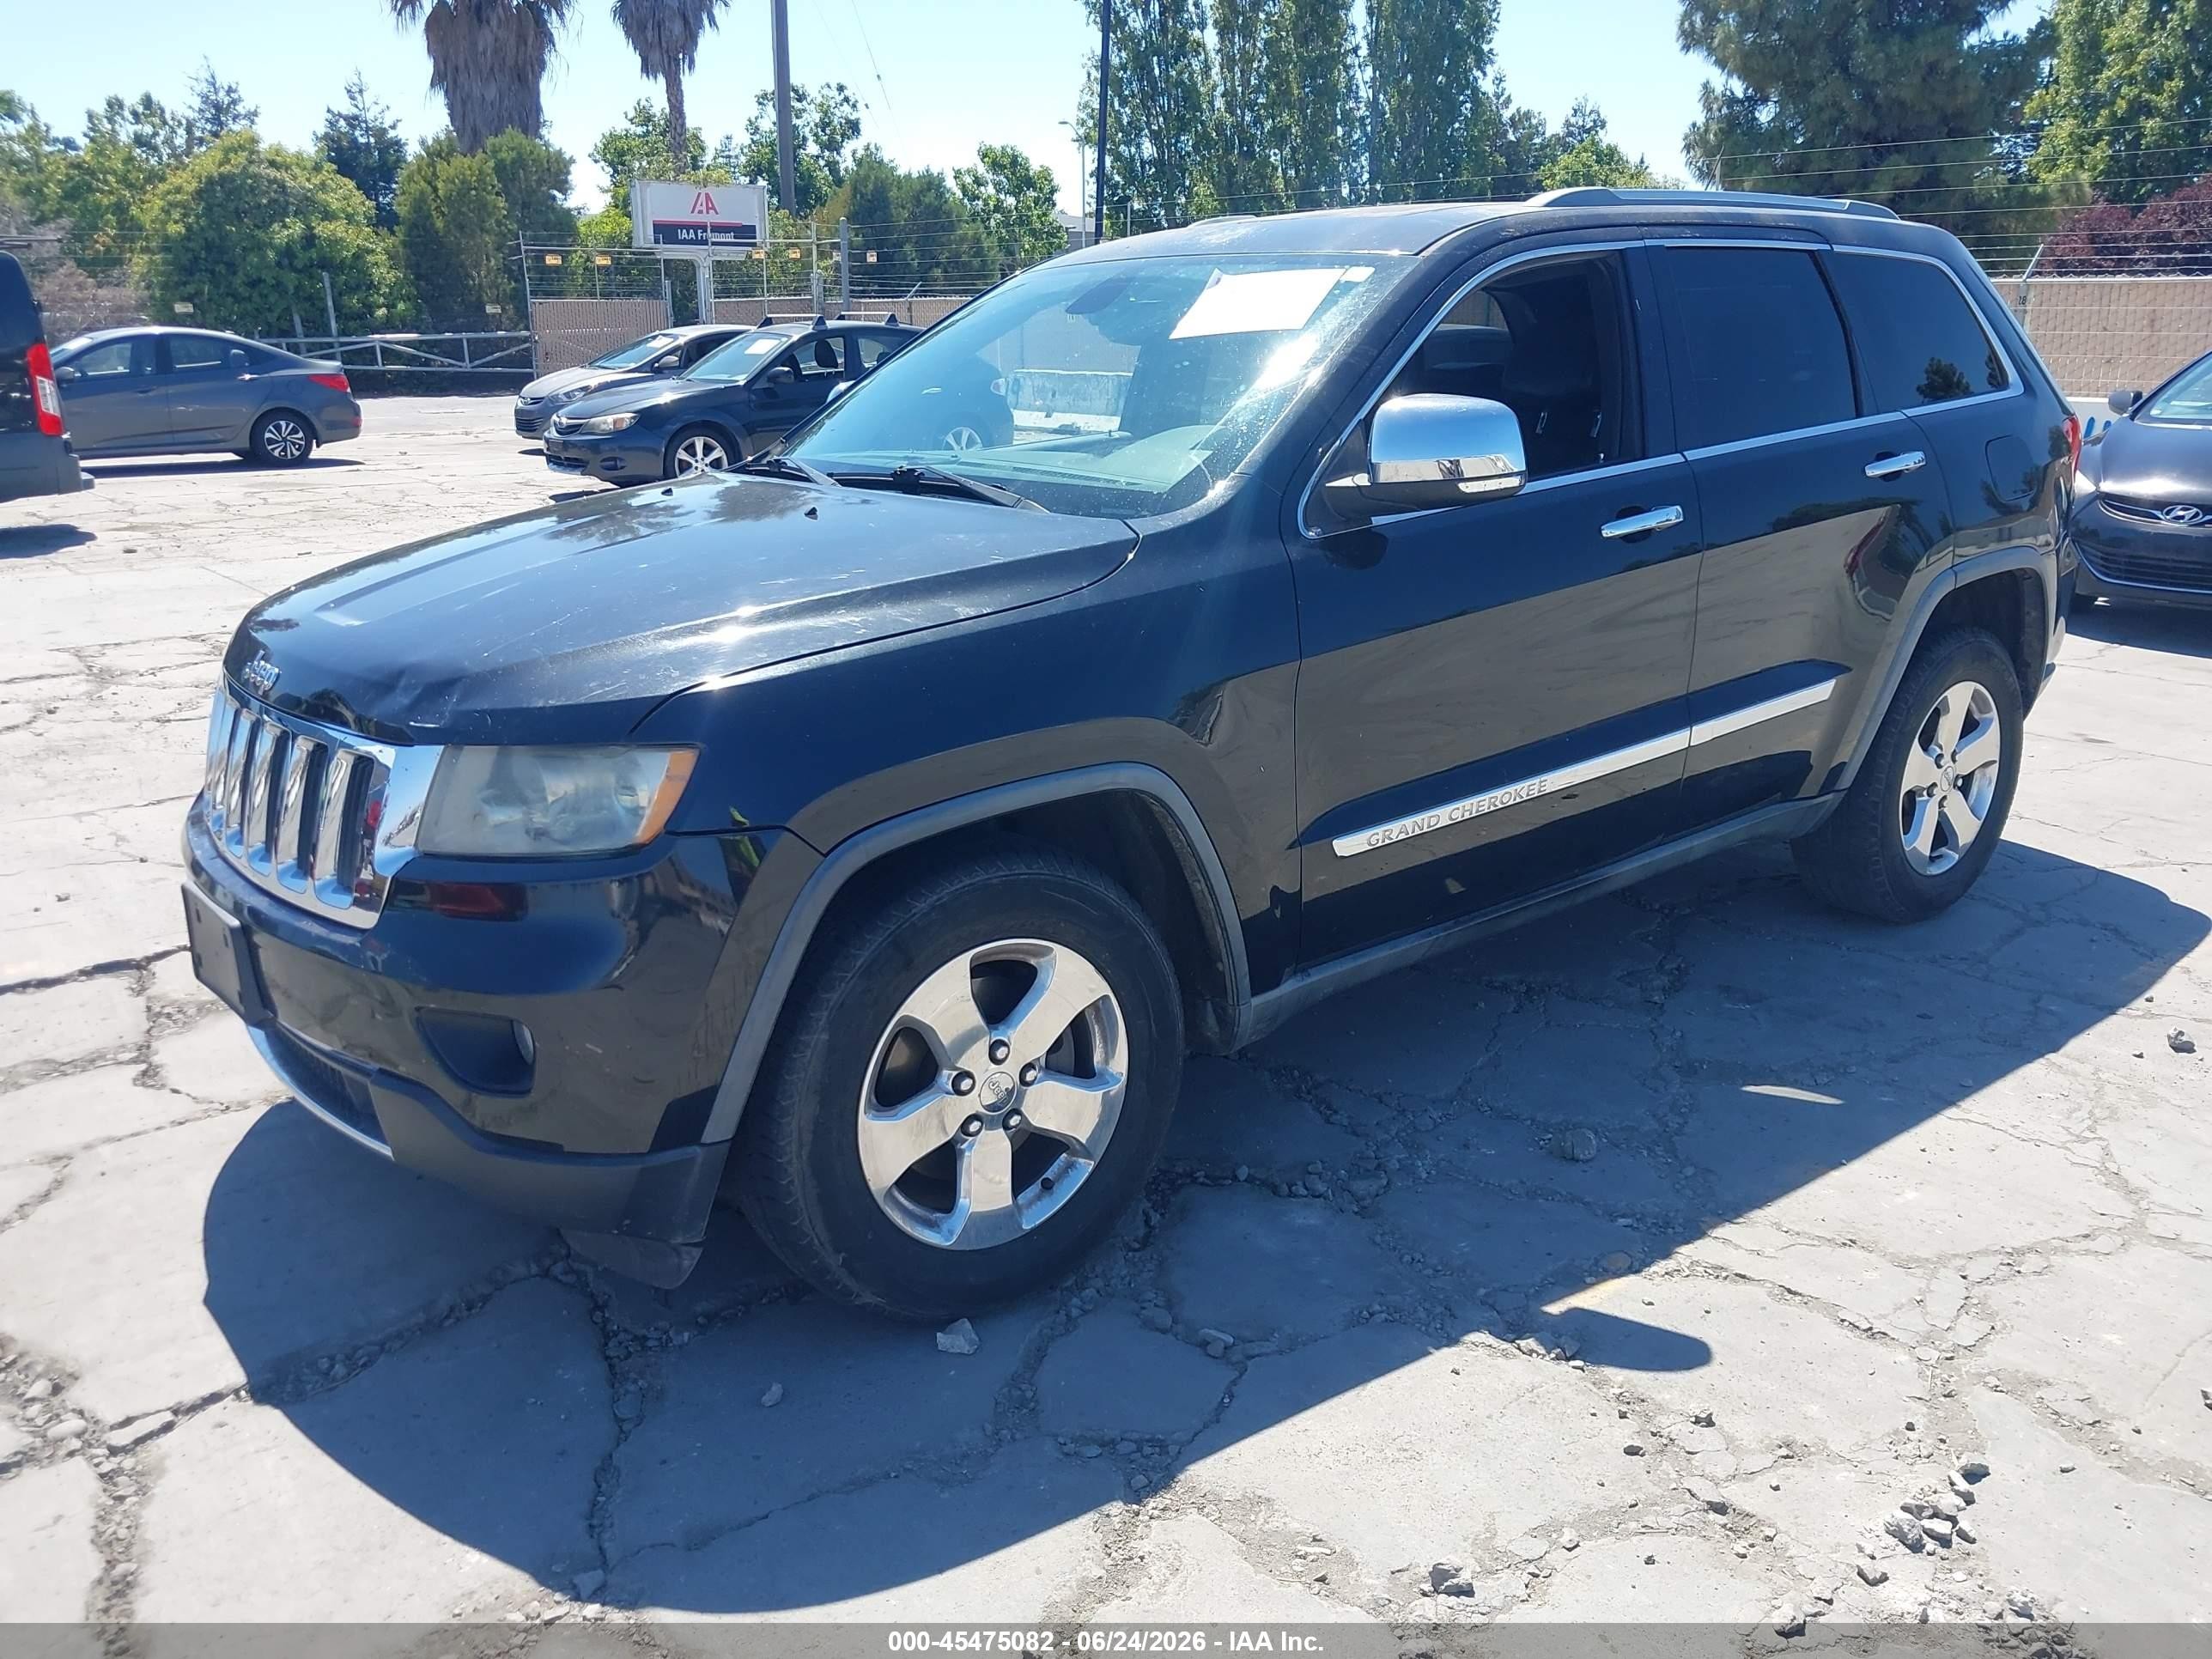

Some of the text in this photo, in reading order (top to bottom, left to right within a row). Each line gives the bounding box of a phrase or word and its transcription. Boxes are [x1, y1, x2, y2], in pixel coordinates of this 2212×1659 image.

[678, 228, 696, 240] IAA
[1367, 777, 1548, 848] GRAND CHEROKEE
